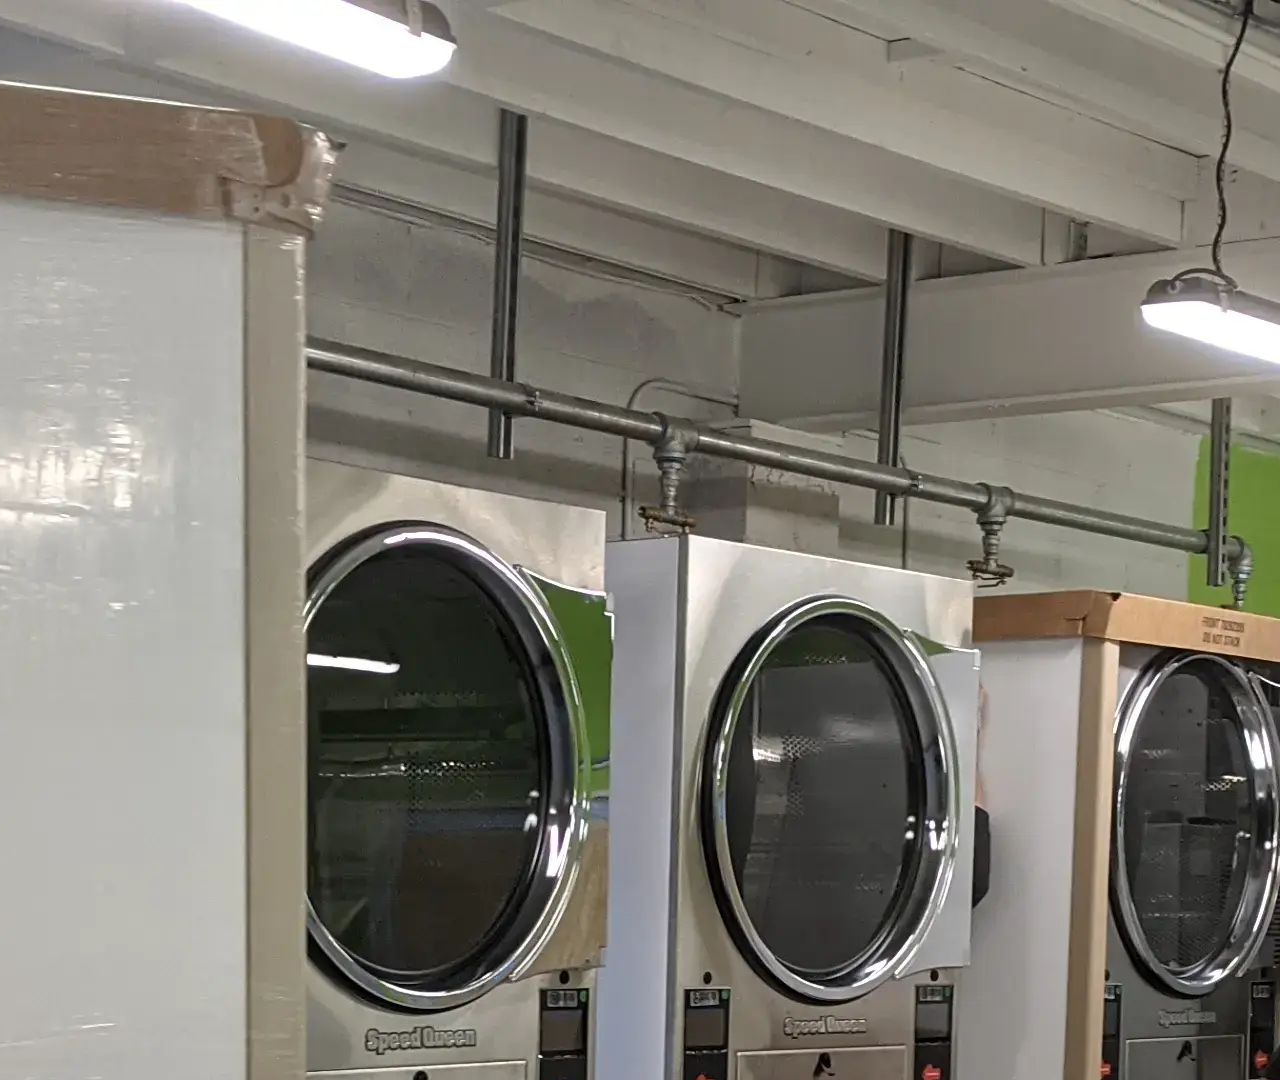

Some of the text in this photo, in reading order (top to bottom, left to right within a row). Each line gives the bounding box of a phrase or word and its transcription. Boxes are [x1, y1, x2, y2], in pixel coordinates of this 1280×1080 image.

[365, 1025, 477, 1055] Speed Queen
[783, 1014, 868, 1040] Speed Queen
